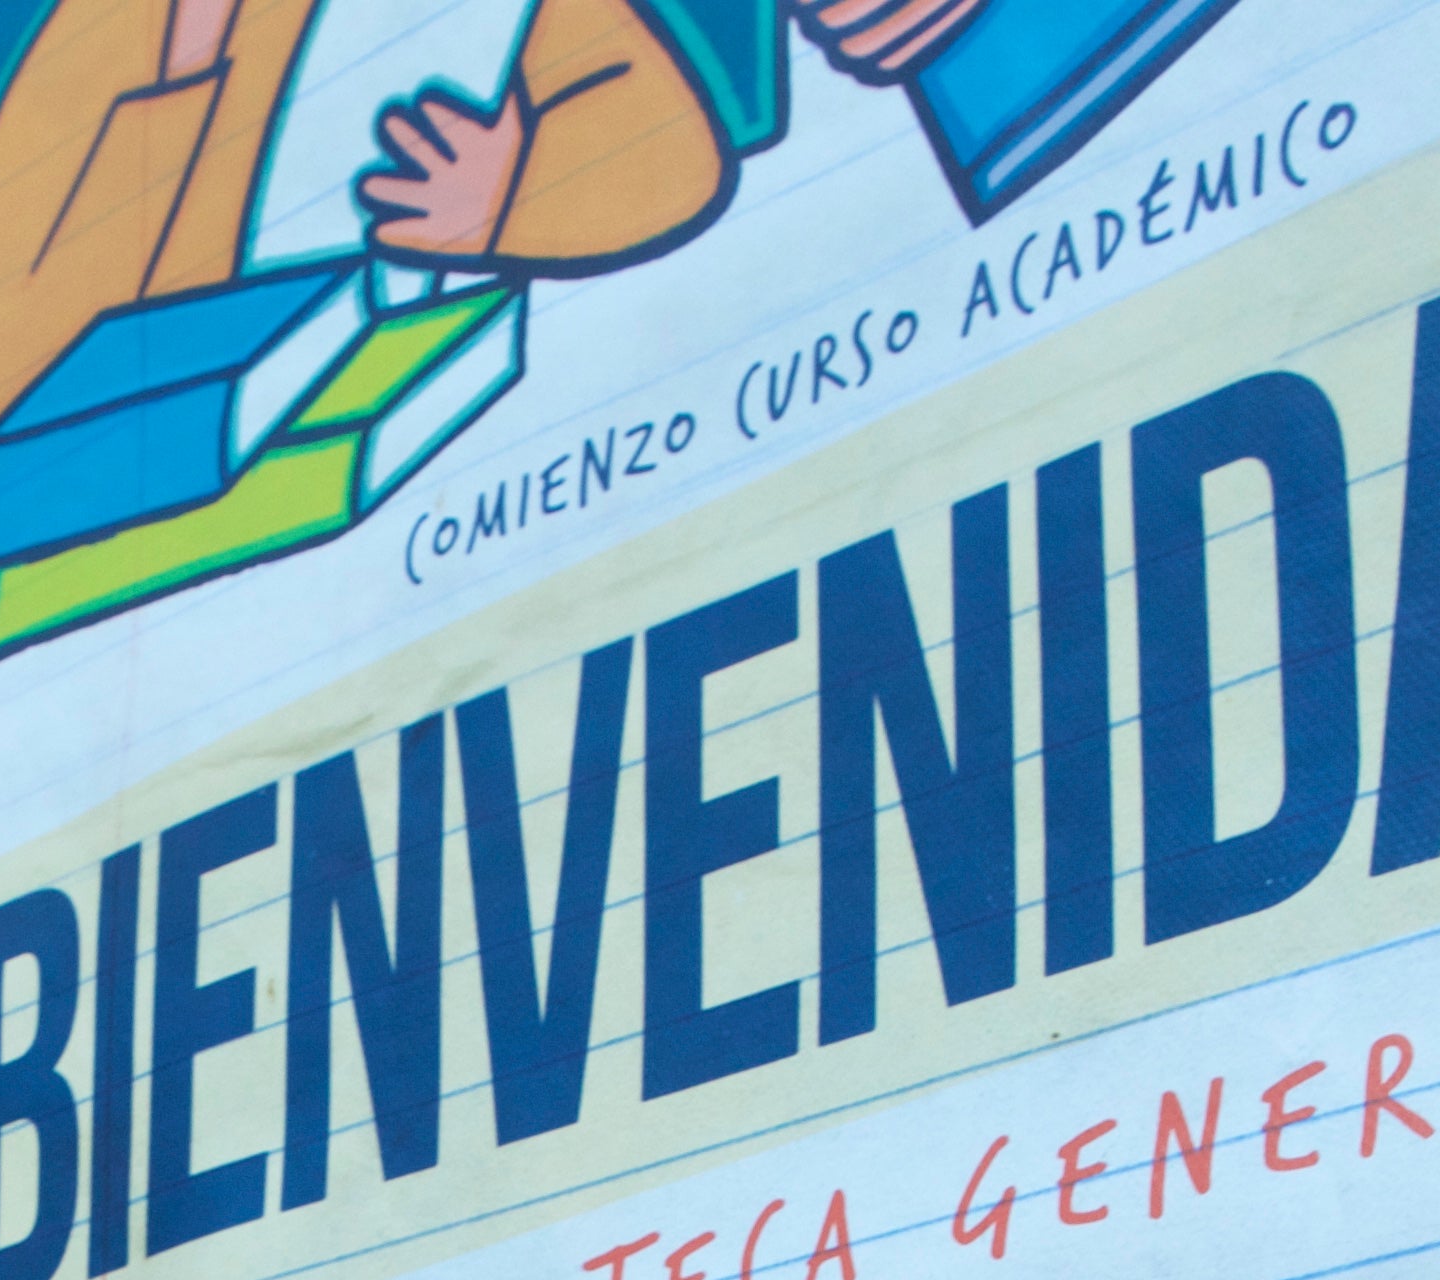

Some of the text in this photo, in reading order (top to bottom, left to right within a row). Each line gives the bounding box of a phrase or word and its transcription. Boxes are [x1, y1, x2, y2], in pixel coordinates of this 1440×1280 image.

[403, 101, 1357, 587] COMIENZO CURSO ACADÉMICO
